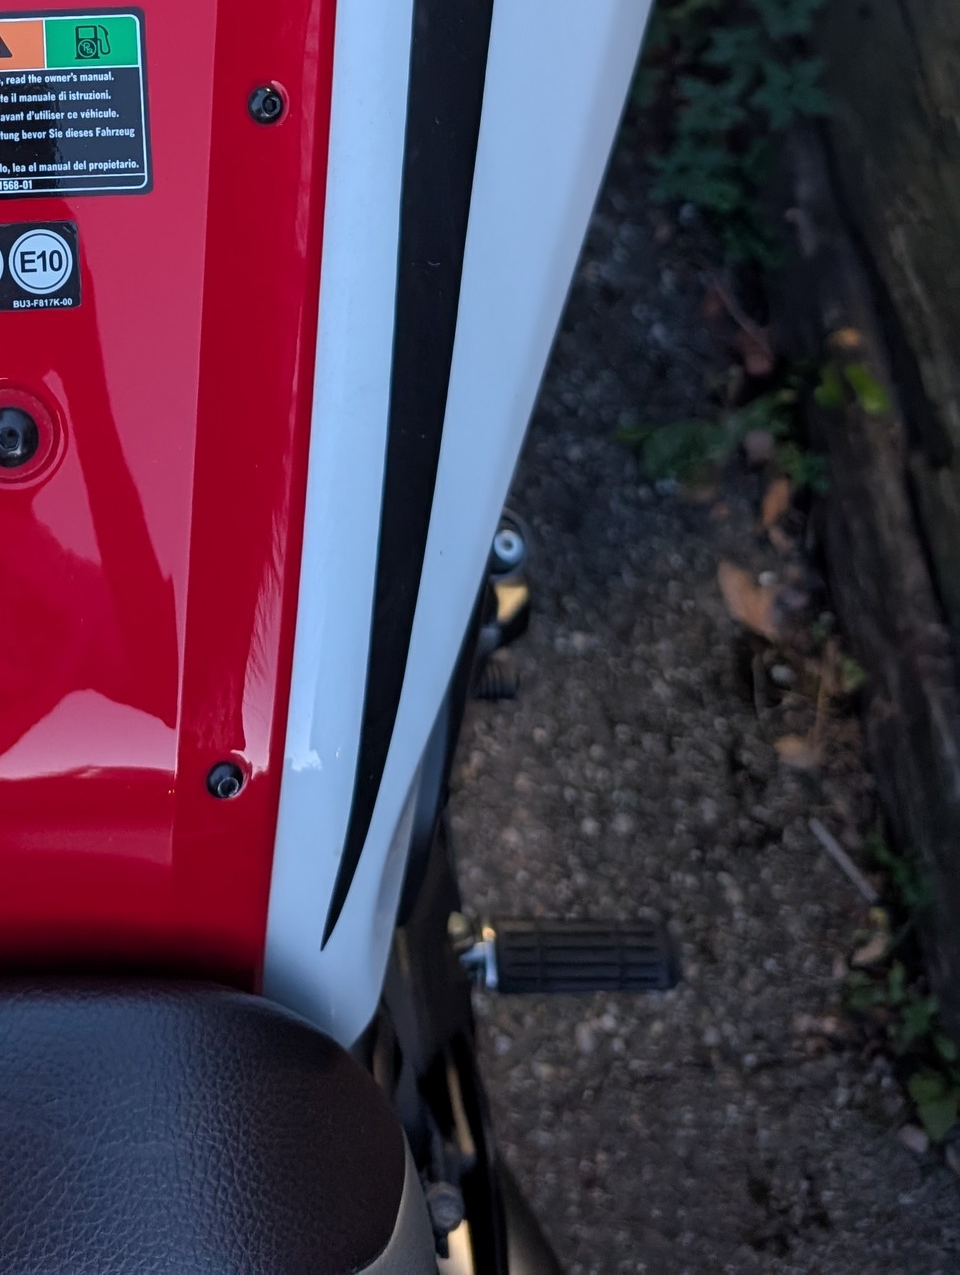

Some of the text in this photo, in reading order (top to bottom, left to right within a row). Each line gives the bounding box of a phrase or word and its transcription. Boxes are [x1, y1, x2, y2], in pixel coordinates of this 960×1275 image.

[6, 74, 26, 84] read
[28, 74, 42, 84] the
[44, 72, 78, 83] owner's
[80, 71, 114, 82] manual.
[11, 93, 17, 103] il
[19, 91, 56, 102] manuale
[58, 91, 67, 101] di
[69, 89, 111, 100] istruzioni.
[0, 111, 24, 122] avant
[26, 110, 65, 121] d'utiliser
[67, 111, 78, 119] ce
[80, 108, 119, 119] véhicule.
[21, 130, 47, 139] bevor
[48, 129, 63, 139] Sie
[65, 129, 94, 138] dieses
[95, 127, 135, 138] Fahrzeug
[12, 163, 26, 172] lea
[28, 162, 37, 172] el
[39, 161, 71, 172] manual
[73, 160, 87, 170] del
[88, 158, 139, 172] propietario.
[20, 250, 63, 273] E10
[13, 298, 73, 308] BU3-F817K-00
